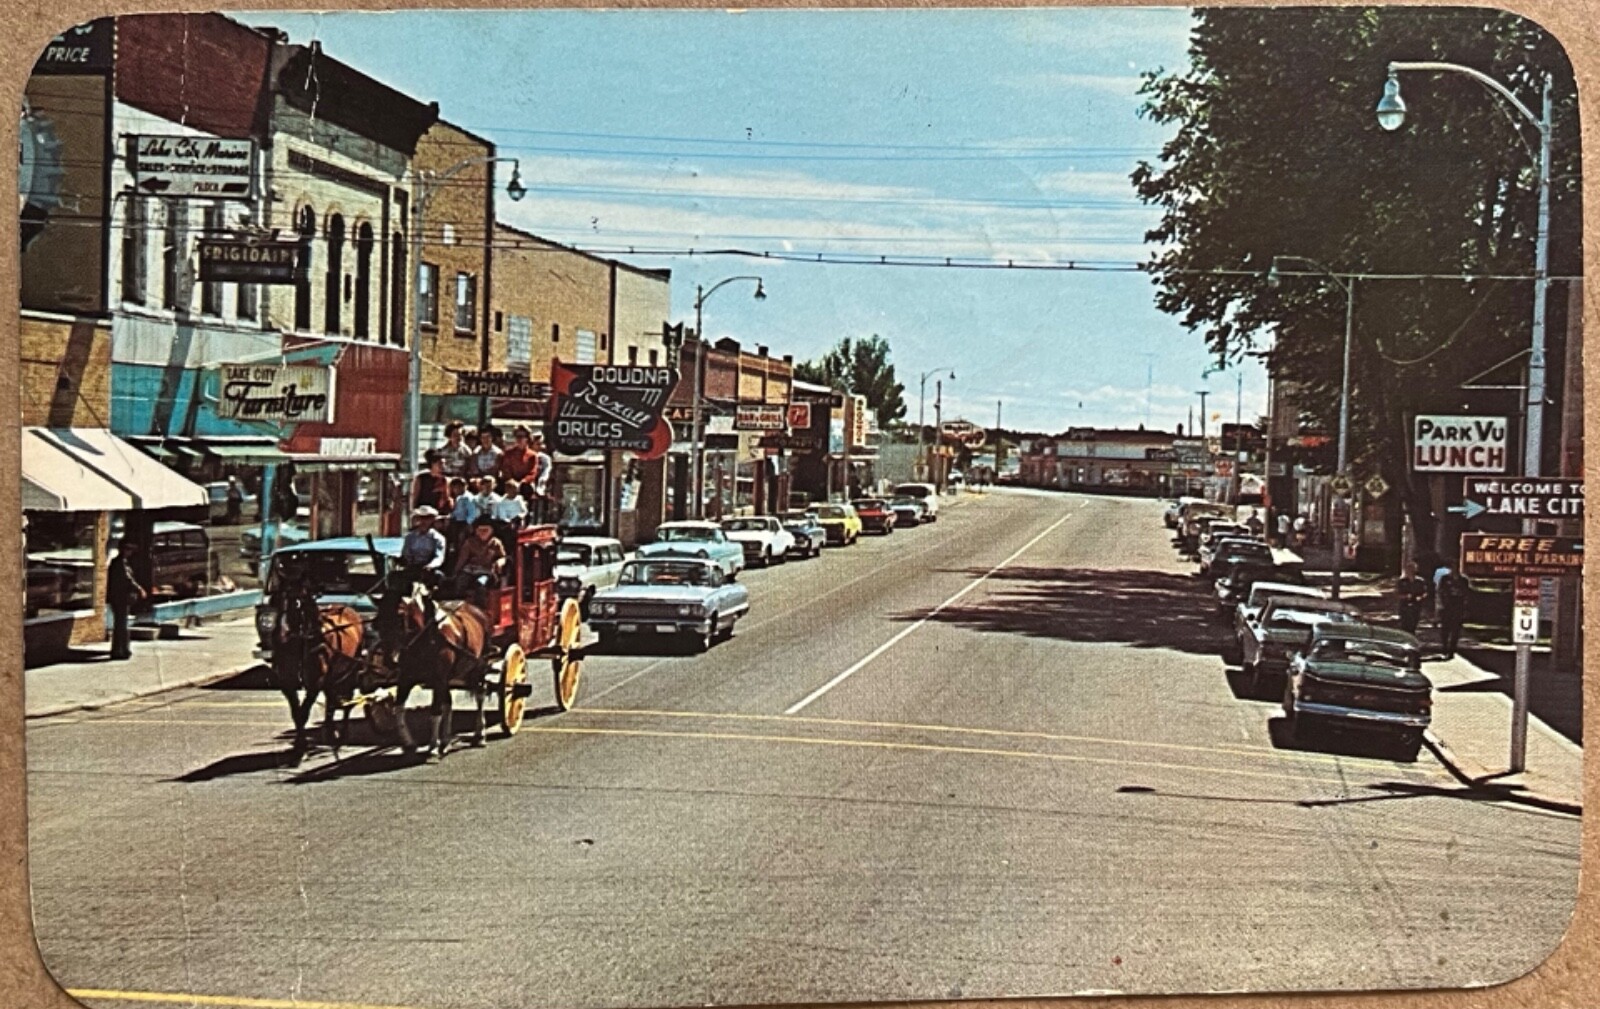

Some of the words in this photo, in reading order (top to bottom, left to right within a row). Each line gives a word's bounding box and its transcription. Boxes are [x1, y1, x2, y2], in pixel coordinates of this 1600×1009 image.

[46, 47, 90, 62] PRICE
[253, 369, 277, 382] CITY
[460, 381, 539, 396] HARDWARE
[224, 382, 327, 418] Furniture
[573, 381, 651, 426] Rexall
[662, 408, 693, 419] CAF
[1417, 419, 1473, 441] PARK
[1474, 420, 1505, 442] VU
[608, 440, 650, 450] SERVICE
[1416, 445, 1504, 468] LUNCH
[1474, 482, 1562, 495] WELCOME
[1486, 497, 1540, 514] LAKE
[1547, 498, 1584, 514] CIT
[1479, 538, 1555, 551] FREE
[1466, 551, 1529, 564] MUNICIPAL
[1521, 619, 1532, 631] U
